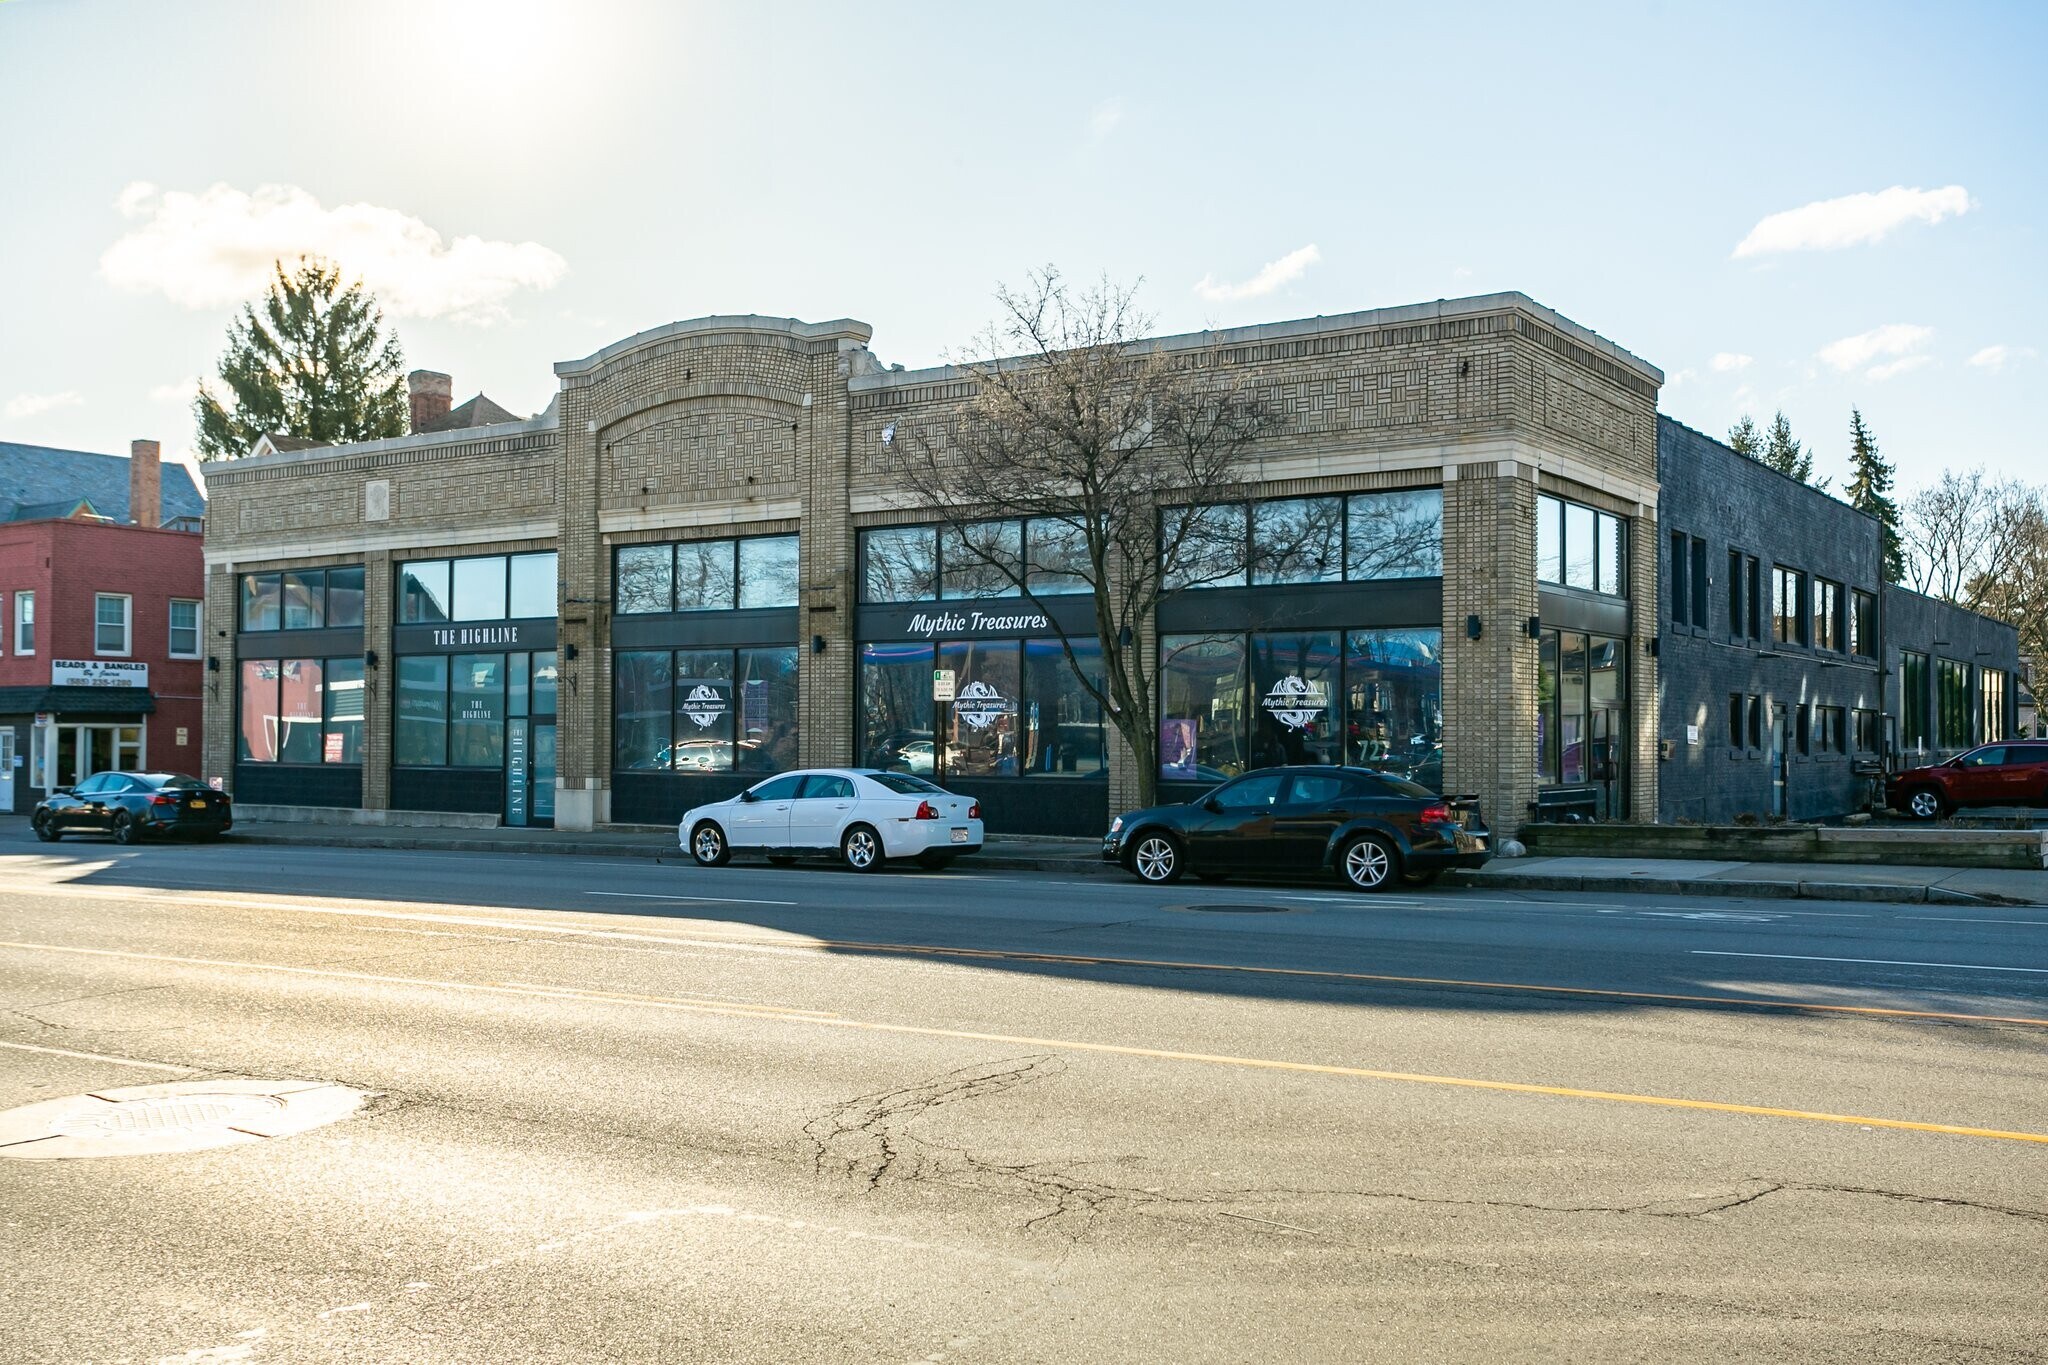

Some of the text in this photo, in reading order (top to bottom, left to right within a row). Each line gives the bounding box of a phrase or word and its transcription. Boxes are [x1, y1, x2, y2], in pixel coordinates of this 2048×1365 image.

[907, 611, 1048, 638] Mythic Treasures
[433, 626, 518, 645] THE HIGHLINE
[55, 661, 86, 669] BEADS
[104, 663, 146, 671] BANGLES
[471, 700, 483, 709] THE
[682, 703, 701, 711] Mythic
[952, 701, 1006, 710] Mythic Treasures
[1261, 697, 1328, 708] Mythic Treasures
[462, 710, 491, 719] HIGHLINE
[512, 738, 523, 815] HIGHLINE
